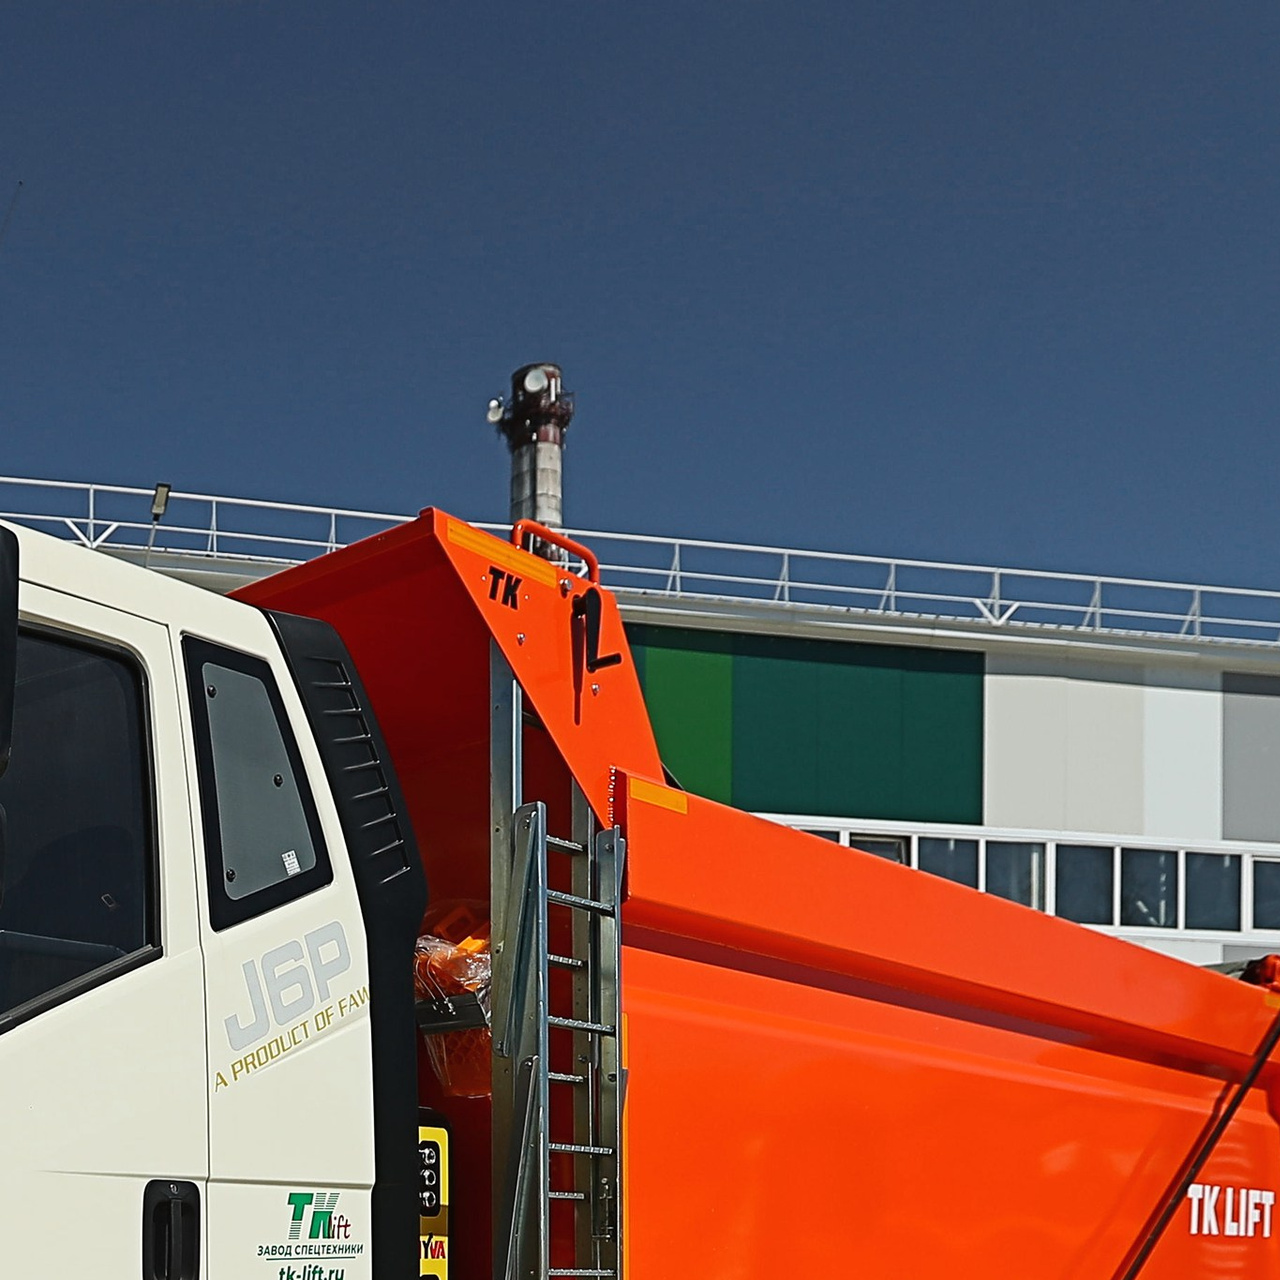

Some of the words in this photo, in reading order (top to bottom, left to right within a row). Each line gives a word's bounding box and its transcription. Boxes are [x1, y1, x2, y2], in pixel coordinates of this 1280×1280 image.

[488, 565, 522, 610] TK
[224, 920, 351, 1051] J6P
[215, 1072, 228, 1092] A
[231, 1020, 309, 1081] PRODUCT
[314, 1005, 335, 1031] OF
[338, 986, 370, 1017] FAW
[1187, 1183, 1221, 1235] TK
[1224, 1187, 1275, 1238] LIFT
[257, 1245, 292, 1257] ЗАВОД
[294, 1244, 363, 1256] СПЕЦТЕХНИКИ
[419, 1232, 446, 1260] YVA
